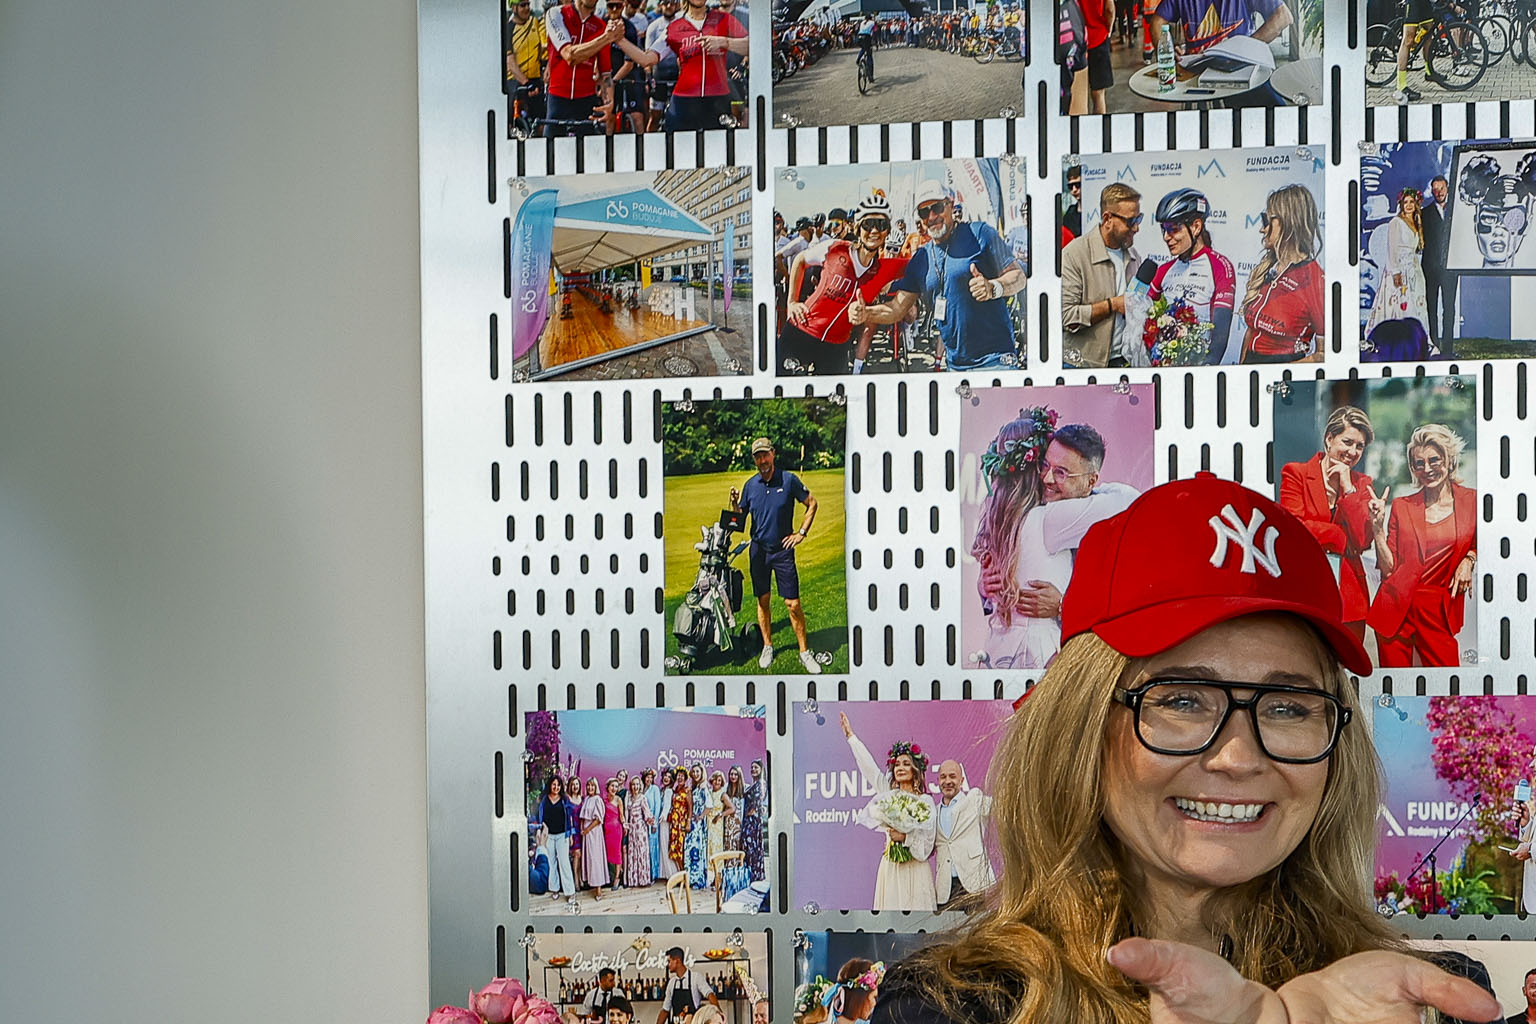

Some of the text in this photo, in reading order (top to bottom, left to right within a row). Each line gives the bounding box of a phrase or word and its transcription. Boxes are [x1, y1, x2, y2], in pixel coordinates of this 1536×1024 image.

[1150, 162, 1182, 171] FUNDACJA
[1246, 155, 1290, 166] FUNDACJA
[1208, 503, 1282, 578] NY
[683, 749, 735, 759] POMAGANIE
[805, 807, 854, 826] Rodziny
[571, 947, 697, 973] Cocktails Cocktls
